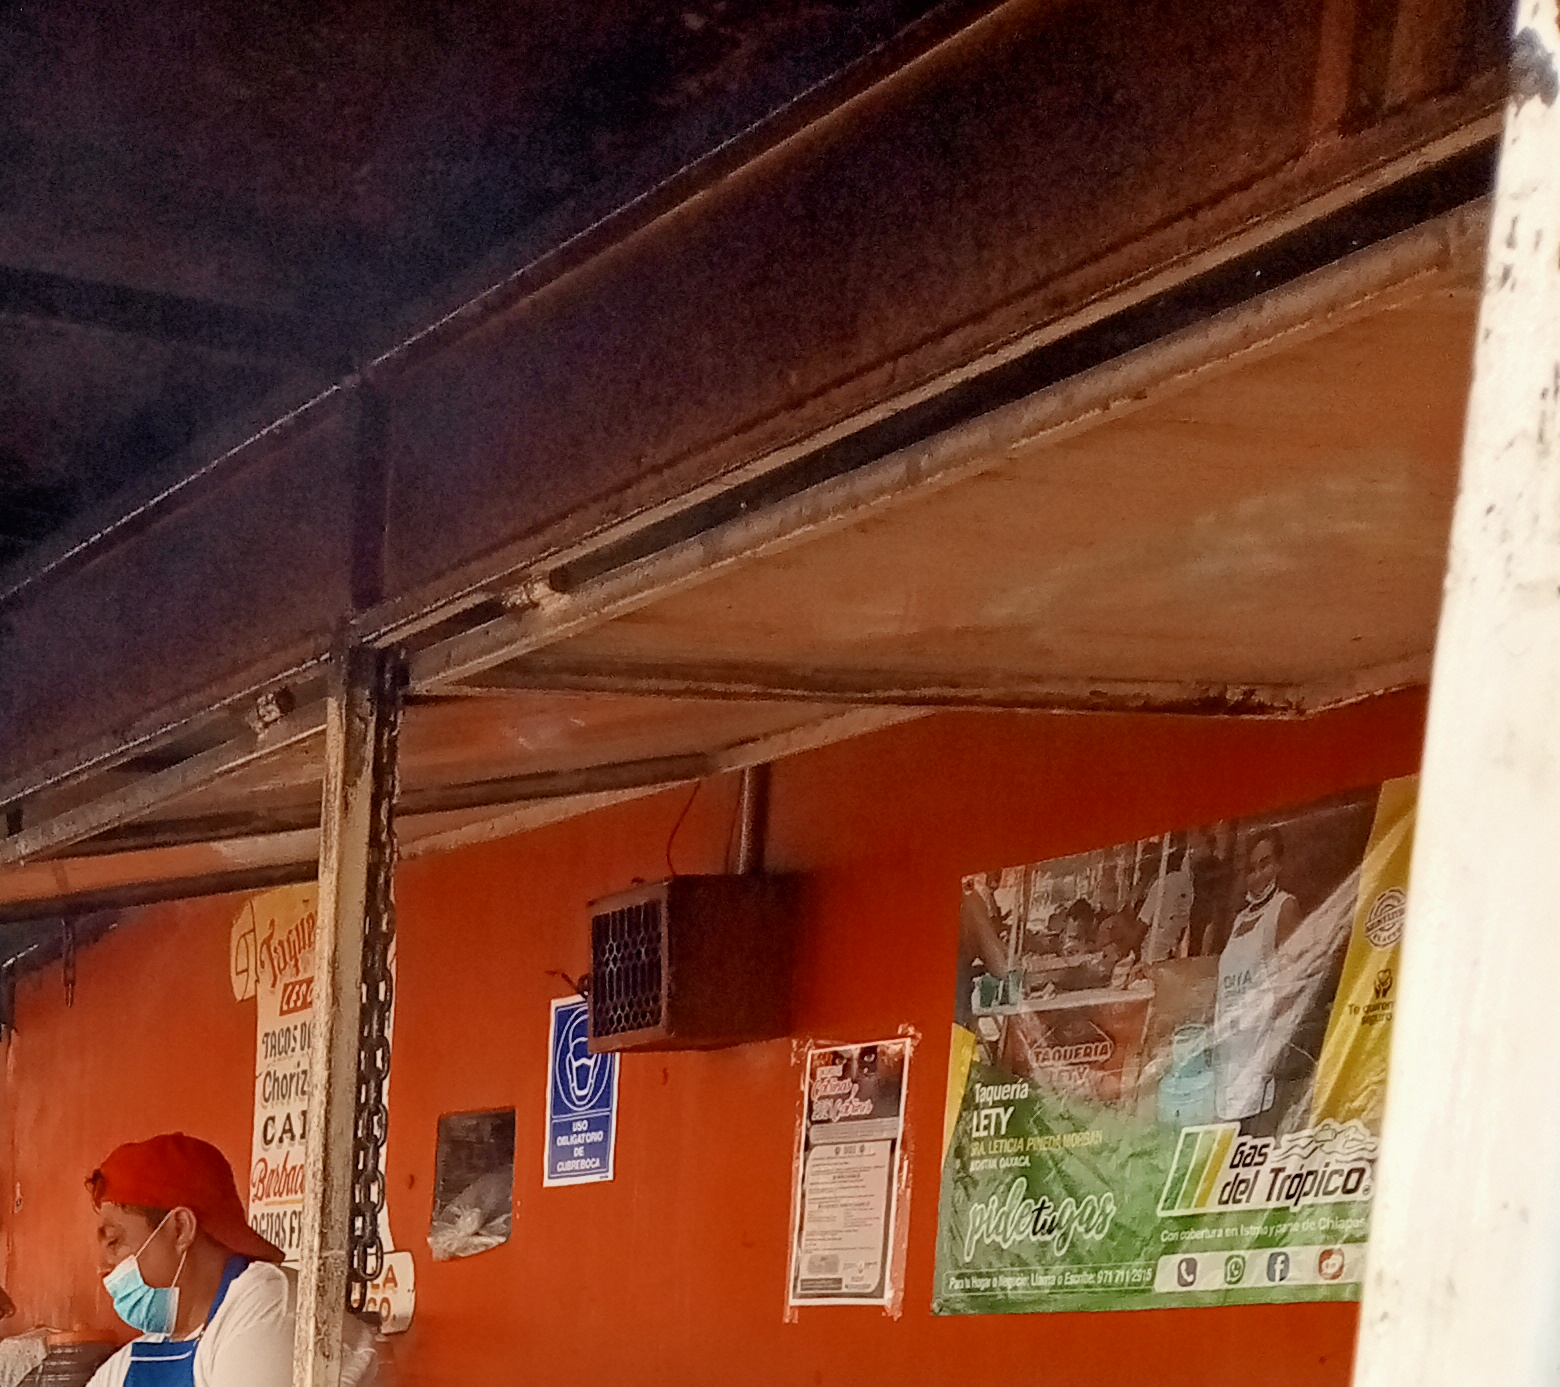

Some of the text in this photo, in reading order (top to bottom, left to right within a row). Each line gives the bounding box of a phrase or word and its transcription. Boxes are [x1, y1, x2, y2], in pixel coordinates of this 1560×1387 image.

[260, 908, 317, 989] Taque
[1349, 1004, 1360, 1015] Te
[262, 1026, 299, 1060] TACOS
[263, 1065, 309, 1103] Choriz
[975, 1078, 1029, 1104] Taquería
[572, 1120, 589, 1132] USO
[972, 1106, 1015, 1138] LETY
[556, 1130, 604, 1146] OBLIGATORIO
[989, 1137, 1024, 1155] LETICIA
[573, 1146, 585, 1157] DE
[1229, 1142, 1271, 1169] Gas
[556, 1158, 601, 1172] CUBREBOCA
[1218, 1162, 1367, 1207] del Trópico
[1160, 1228, 1179, 1242] Con
[1180, 1226, 1225, 1240] cobertura
[1226, 1225, 1239, 1238] en
